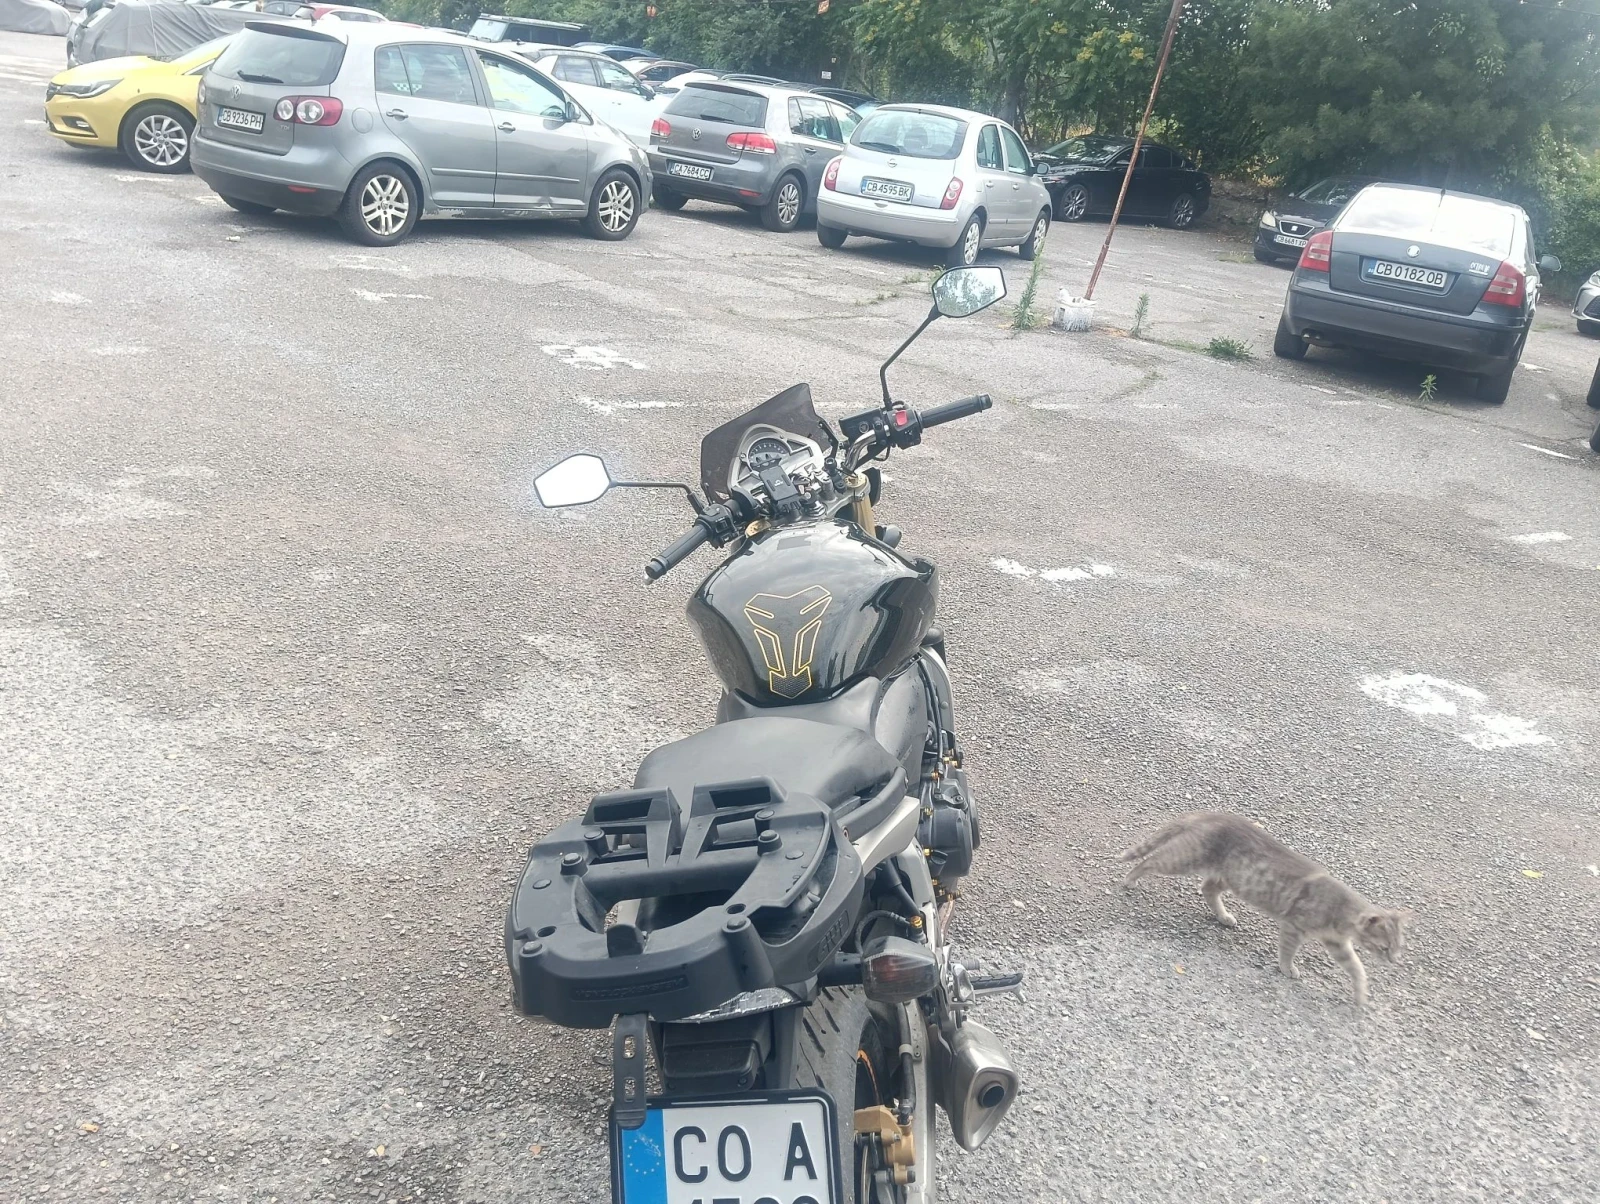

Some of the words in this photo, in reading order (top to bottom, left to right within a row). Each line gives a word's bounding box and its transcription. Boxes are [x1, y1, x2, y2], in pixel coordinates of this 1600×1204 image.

[222, 109, 232, 122] CB
[232, 111, 249, 125] 9236
[249, 114, 262, 128] PH
[674, 164, 683, 174] CA
[682, 165, 699, 176] 7684
[699, 168, 710, 178] CC
[866, 181, 878, 192] CB
[878, 184, 898, 195] 4595
[898, 187, 910, 197] BK
[1376, 262, 1393, 276] CB
[1394, 266, 1424, 282] 0182
[1426, 271, 1444, 285] OB
[673, 1124, 752, 1184] CO
[783, 1121, 818, 1181] A
